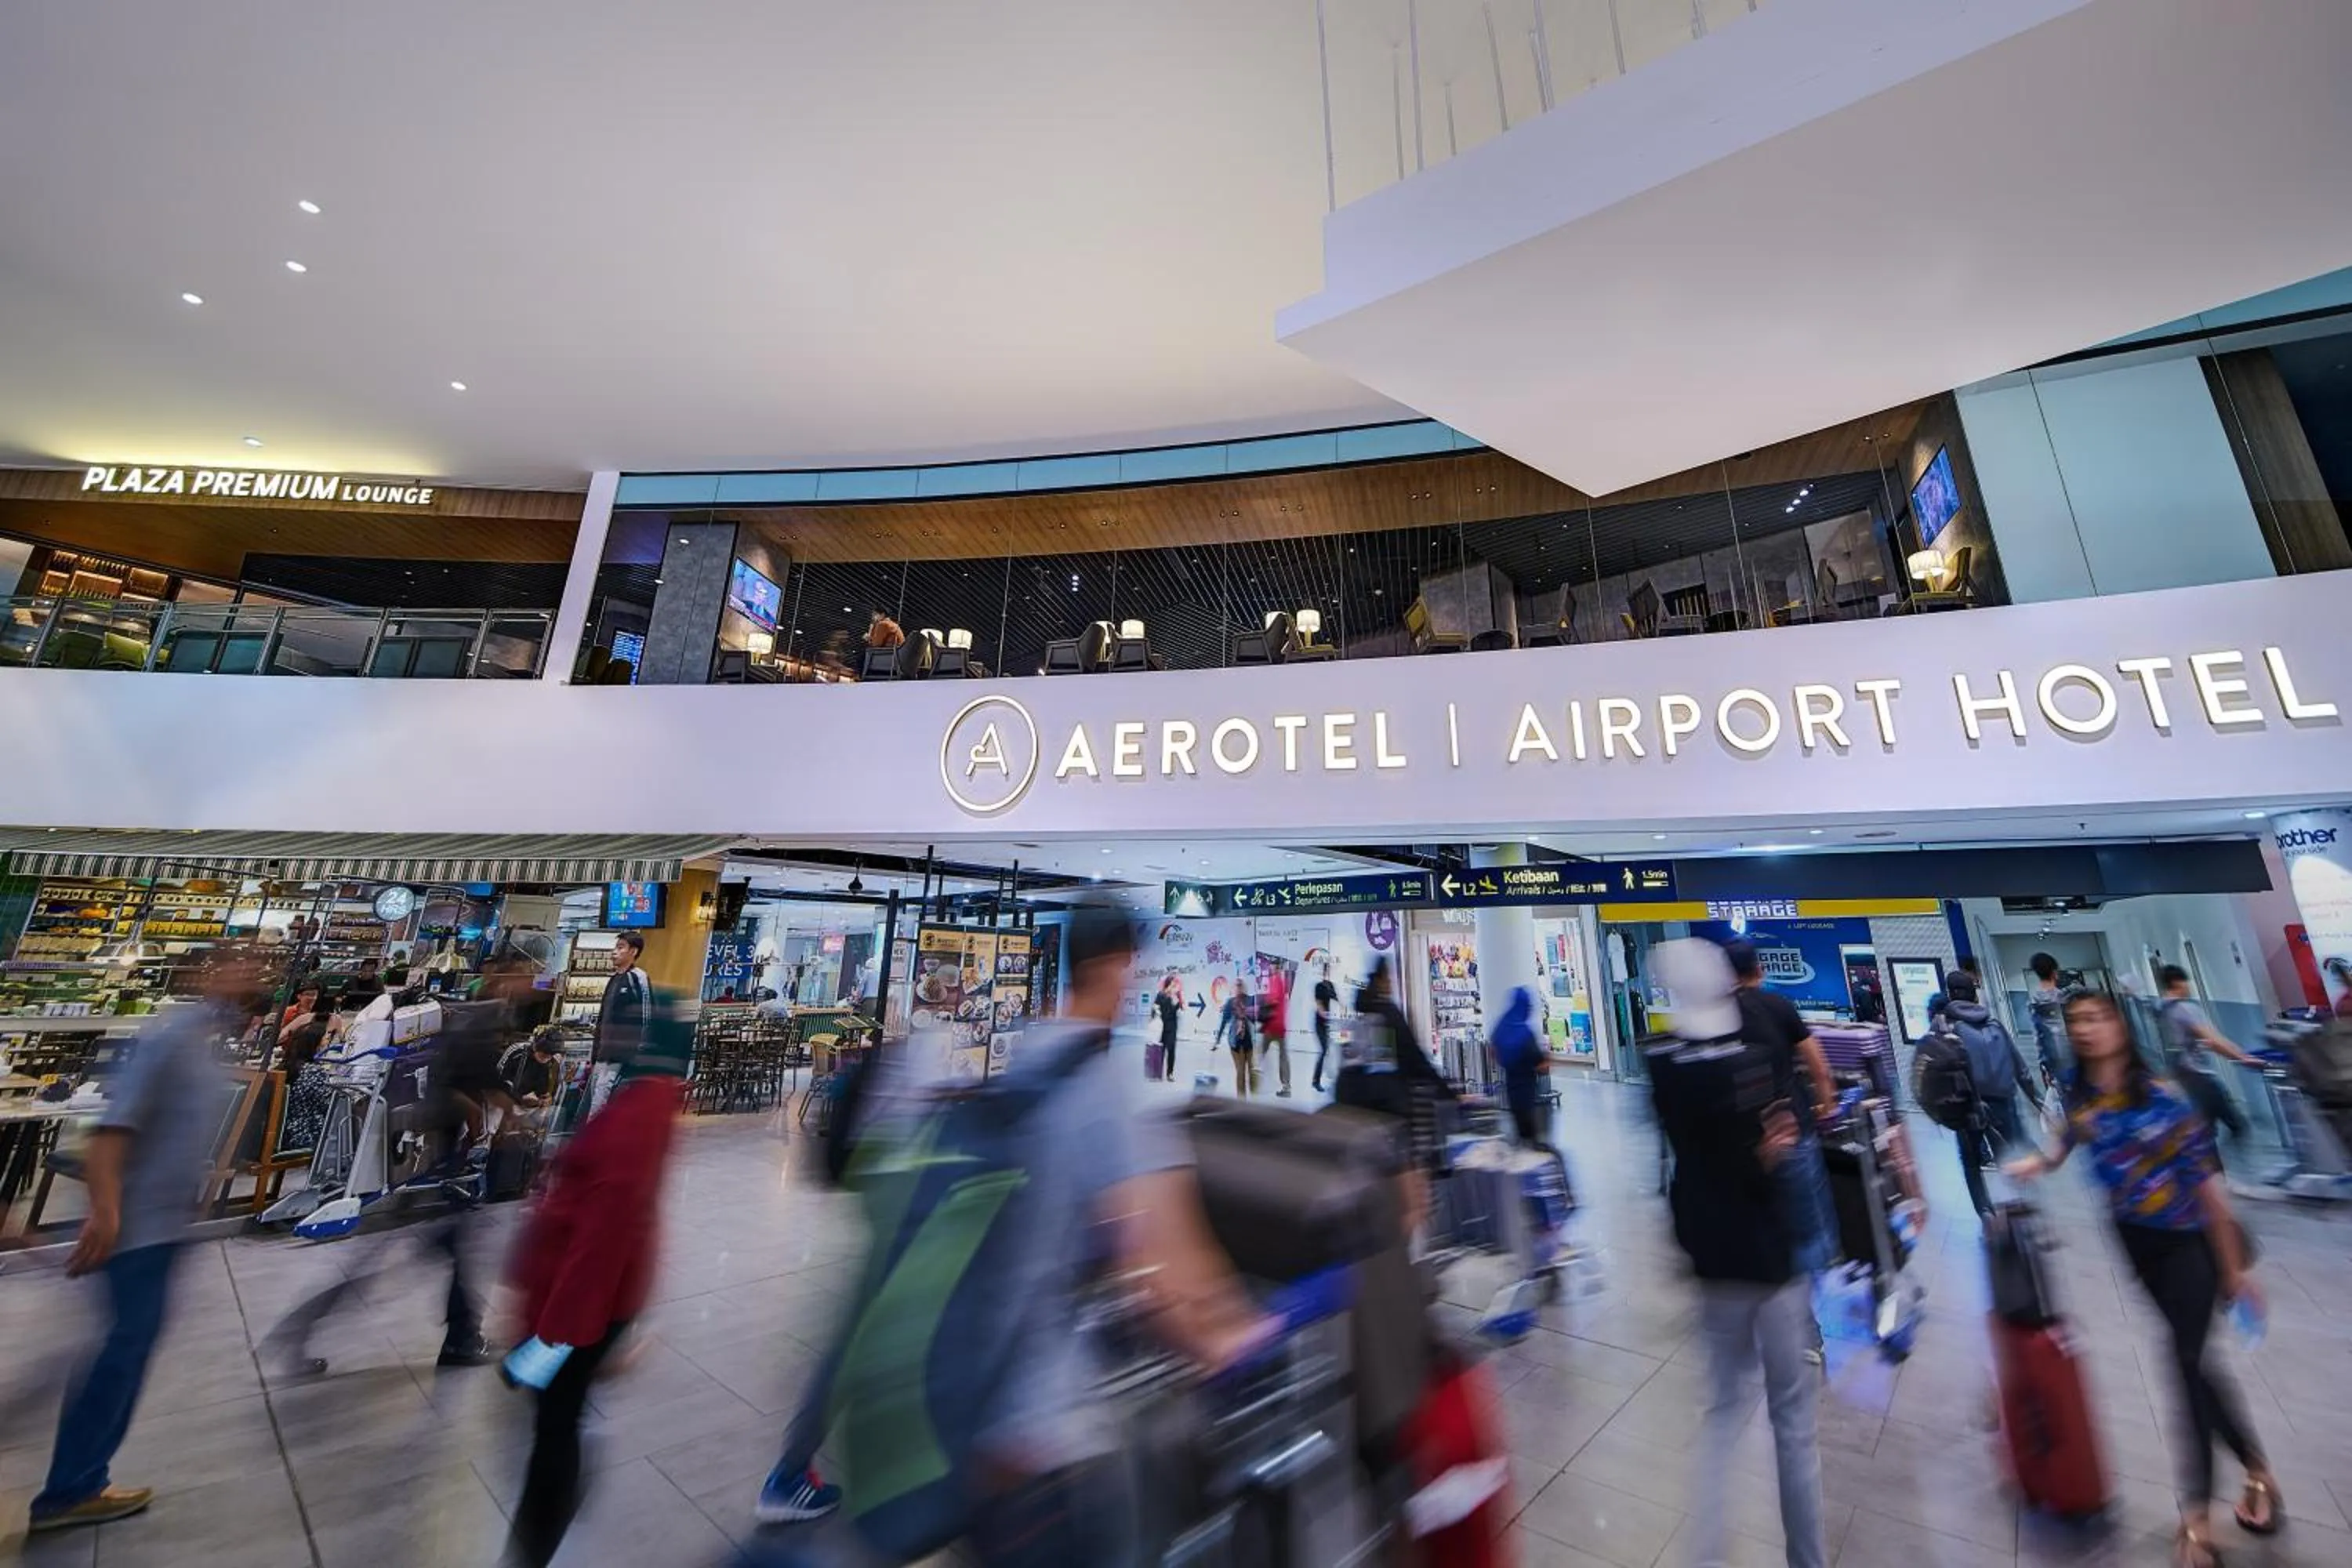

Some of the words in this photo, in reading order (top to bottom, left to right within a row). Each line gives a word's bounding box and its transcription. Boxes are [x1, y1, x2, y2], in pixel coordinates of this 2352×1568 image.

[82, 466, 185, 494] PLAZA
[191, 470, 340, 500] PREMIUM
[343, 485, 434, 504] LOUNGE
[1055, 712, 1406, 778] AEROTEL
[1508, 679, 1901, 762] AIRPORT
[1952, 647, 2339, 740] HOTEL
[1504, 869, 1559, 884] Ketibaan
[1294, 881, 1343, 897] Perlepasan
[1463, 883, 1476, 895] L2
[1266, 894, 1276, 905] L3
[1759, 953, 1799, 962] GAGE
